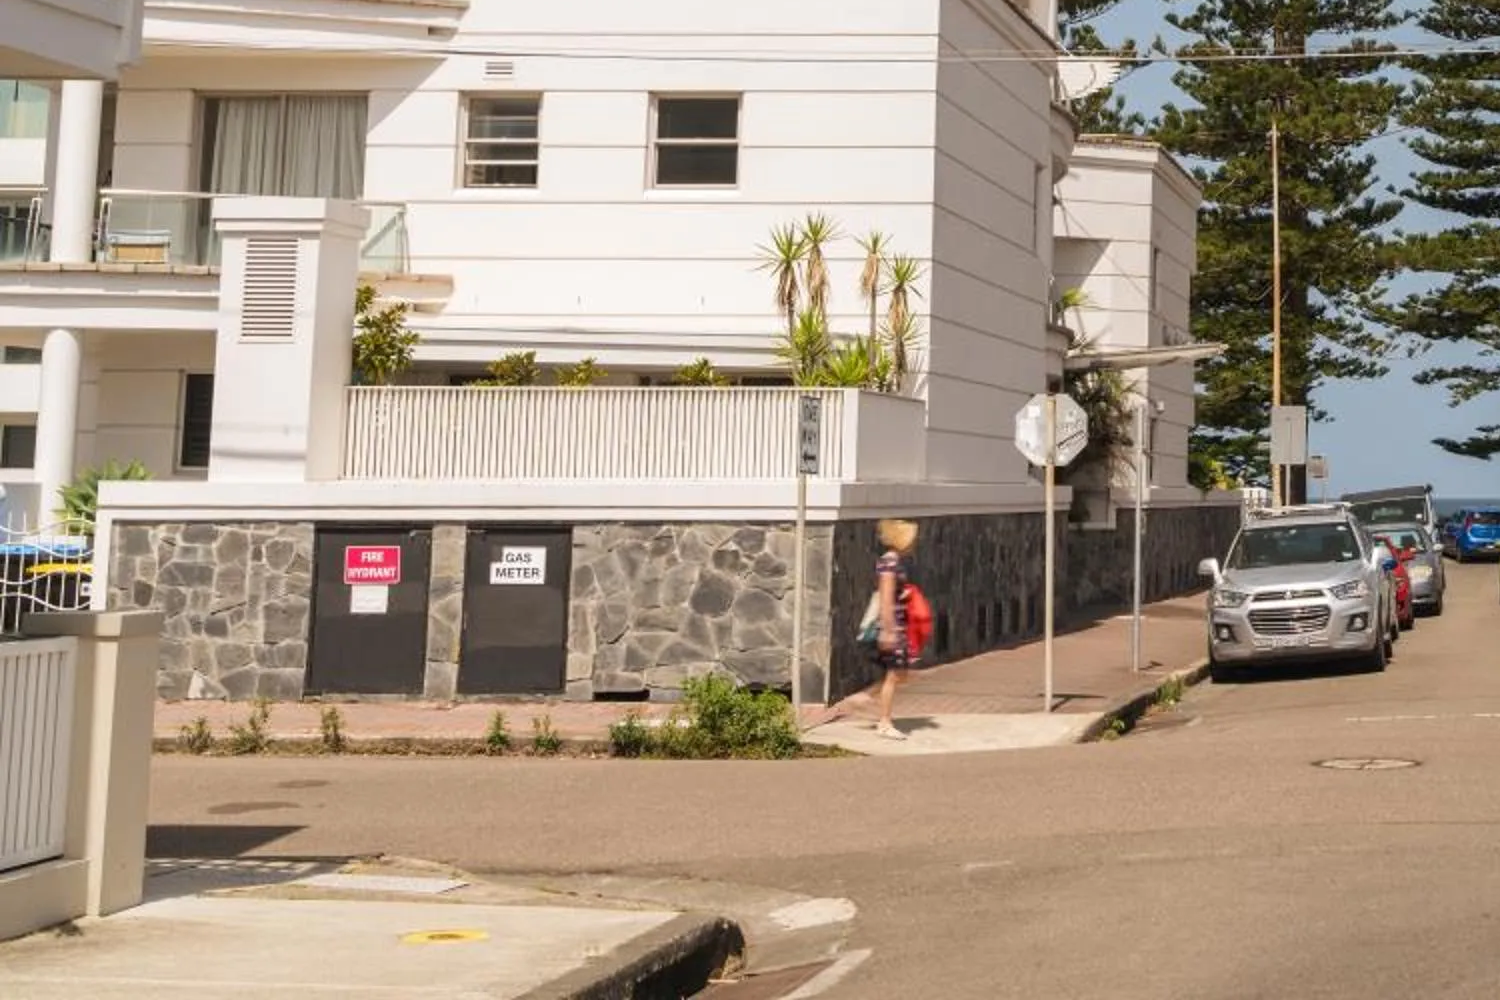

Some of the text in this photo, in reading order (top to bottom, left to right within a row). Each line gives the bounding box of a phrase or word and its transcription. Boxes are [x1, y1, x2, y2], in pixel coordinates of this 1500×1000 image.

[361, 551, 384, 563] FIRE
[505, 552, 532, 563] GAS
[347, 567, 396, 579] HYDRANT
[495, 567, 540, 579] METER
